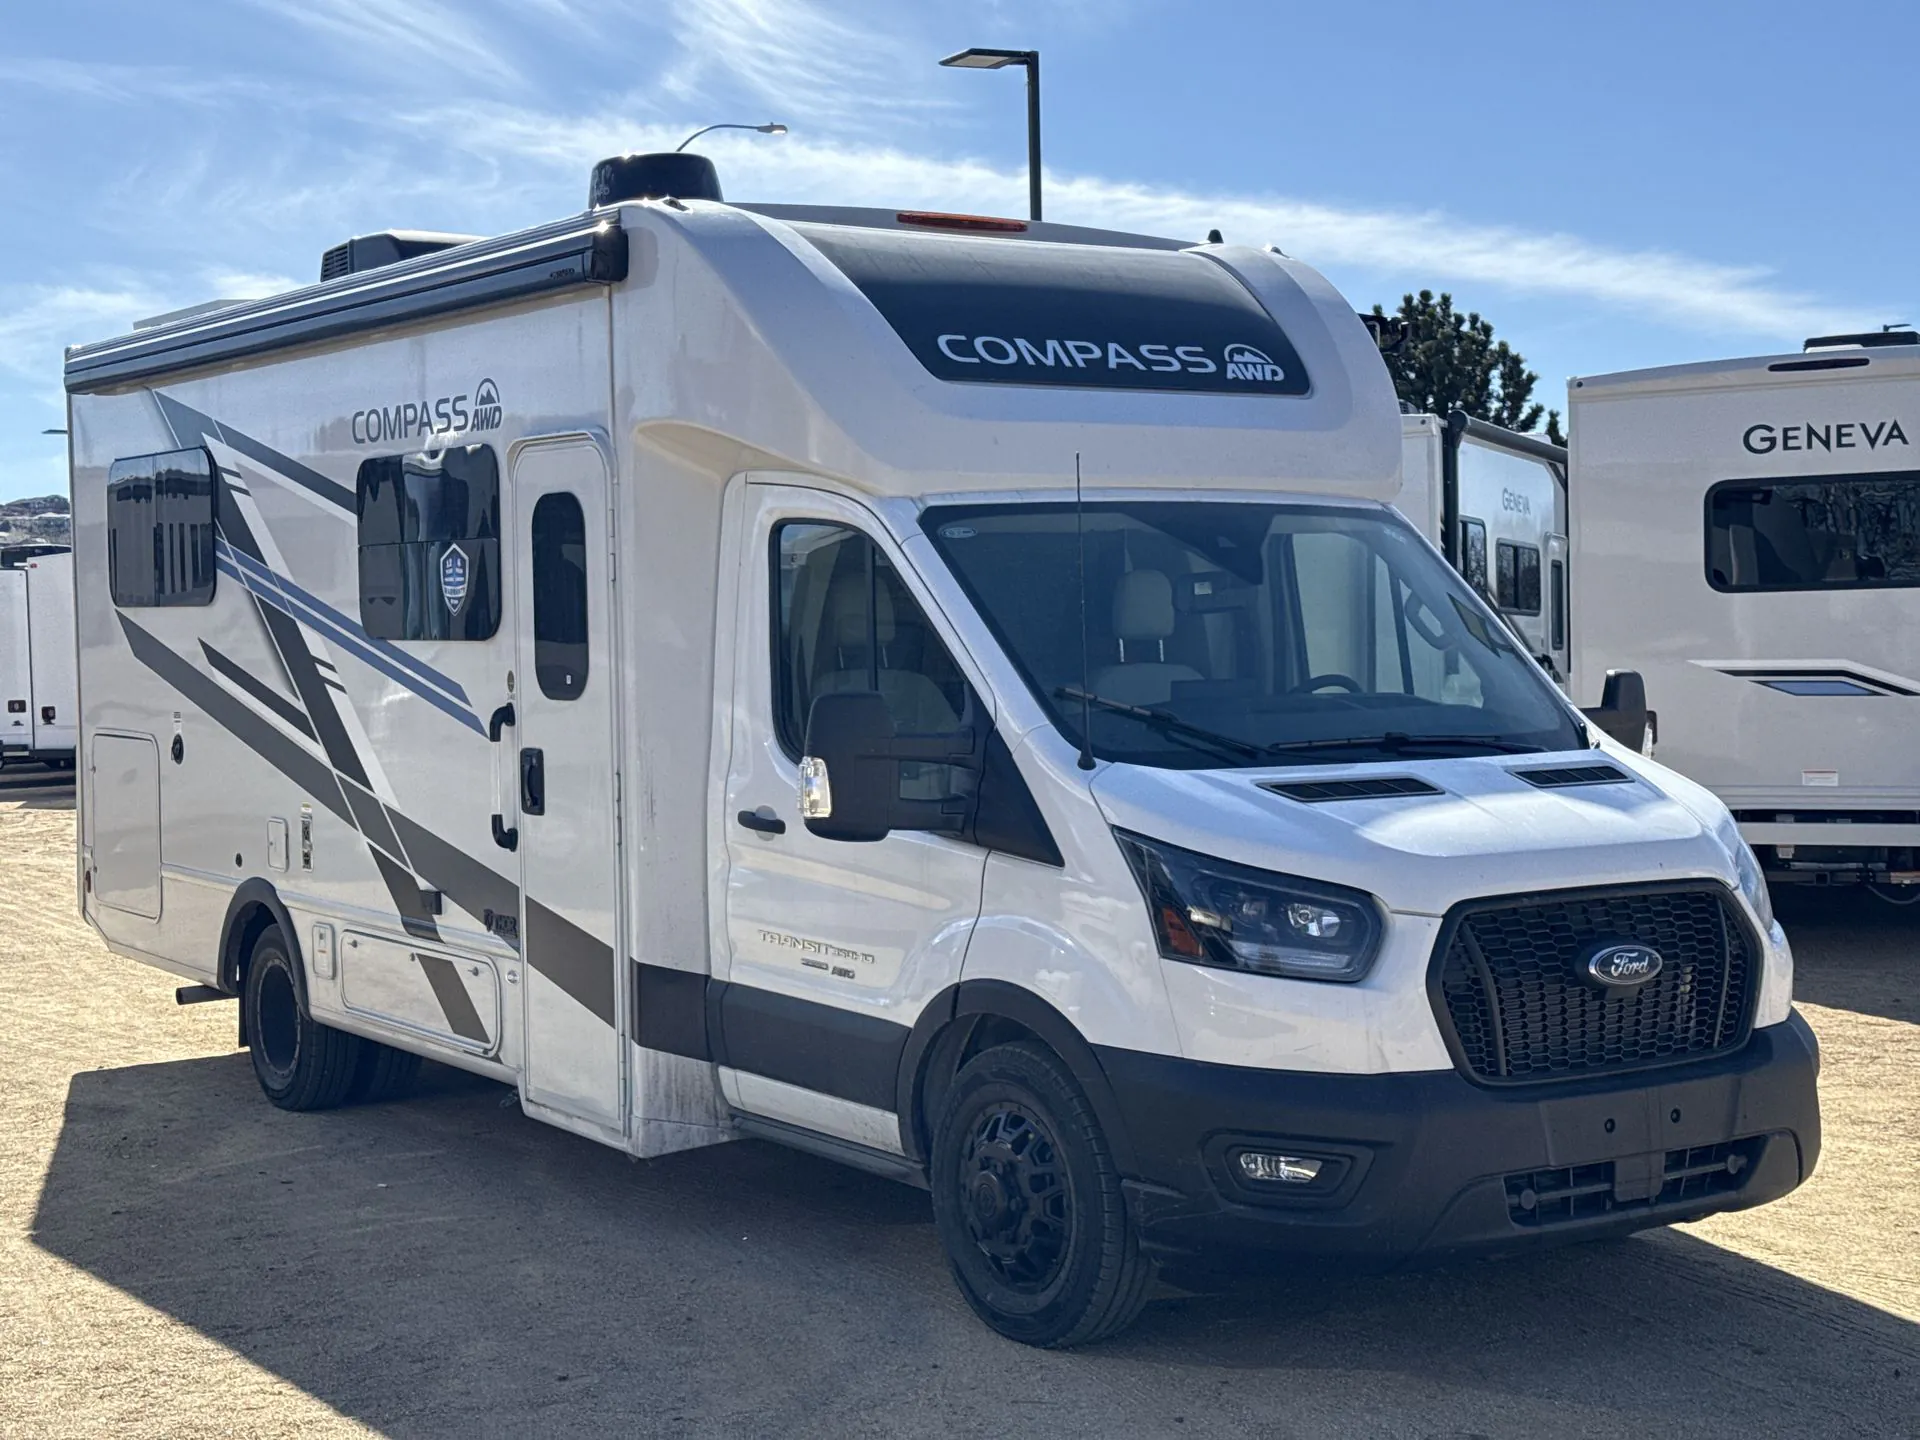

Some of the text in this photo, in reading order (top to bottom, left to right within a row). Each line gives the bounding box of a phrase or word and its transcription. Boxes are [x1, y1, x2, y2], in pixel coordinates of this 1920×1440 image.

[937, 334, 1284, 381] COMPASS AWD
[352, 395, 502, 444] COMPASS AWD
[1742, 419, 1909, 454] GENEVA
[1502, 487, 1531, 516] GENEVA
[758, 929, 832, 955] TRANSIT
[1611, 952, 1649, 977] Ford
